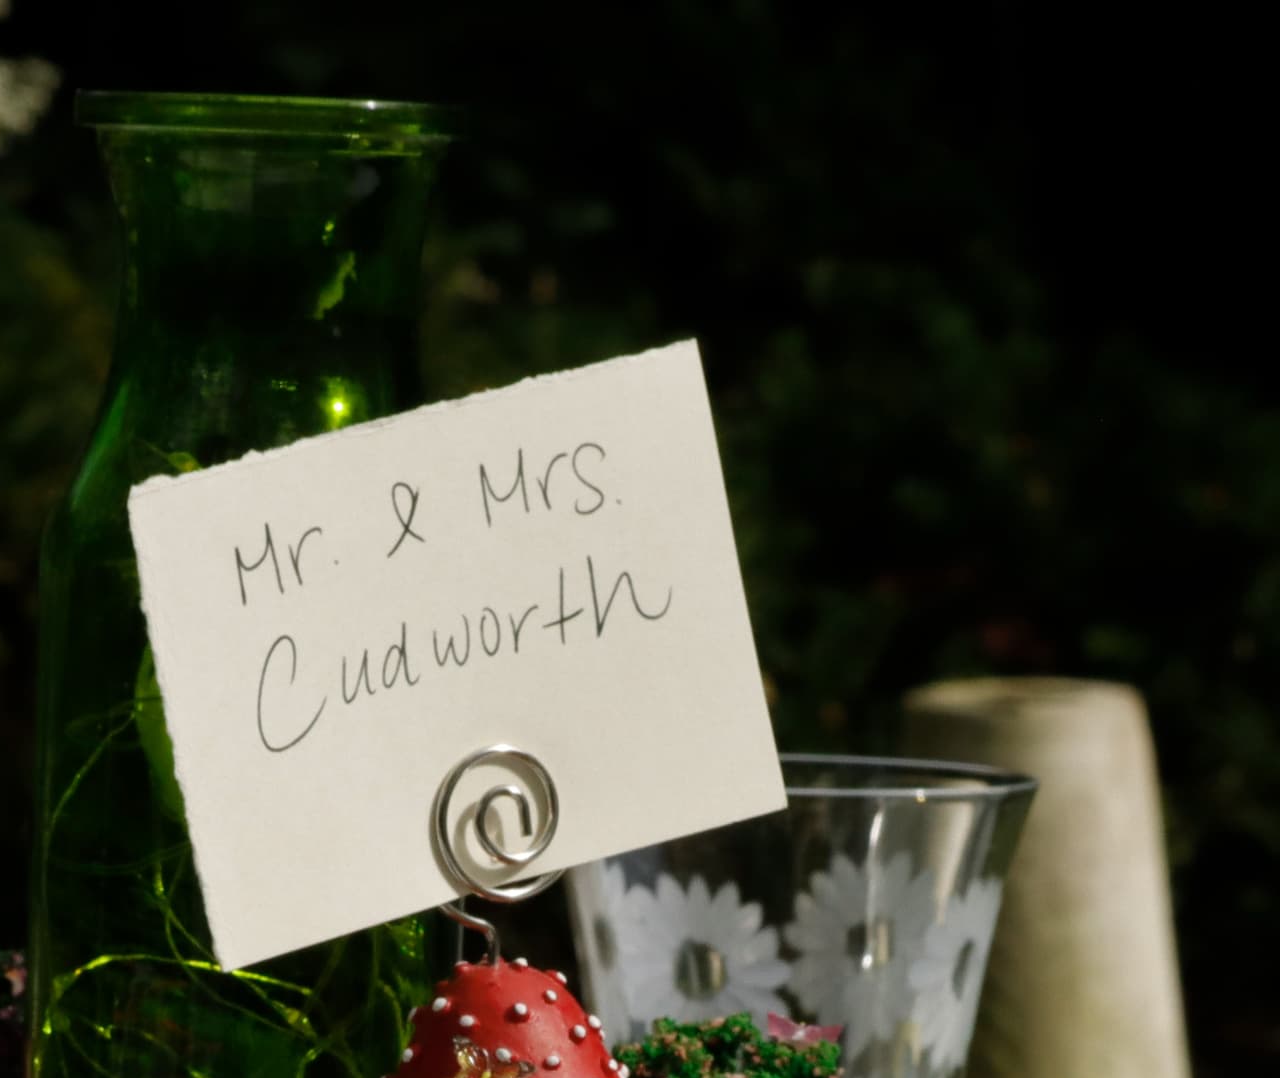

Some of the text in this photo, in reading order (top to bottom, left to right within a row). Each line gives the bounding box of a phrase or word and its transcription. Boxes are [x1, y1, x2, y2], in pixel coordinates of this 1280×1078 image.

[234, 442, 623, 606] Mr. & Mrs.
[256, 555, 673, 753] Cudworth
